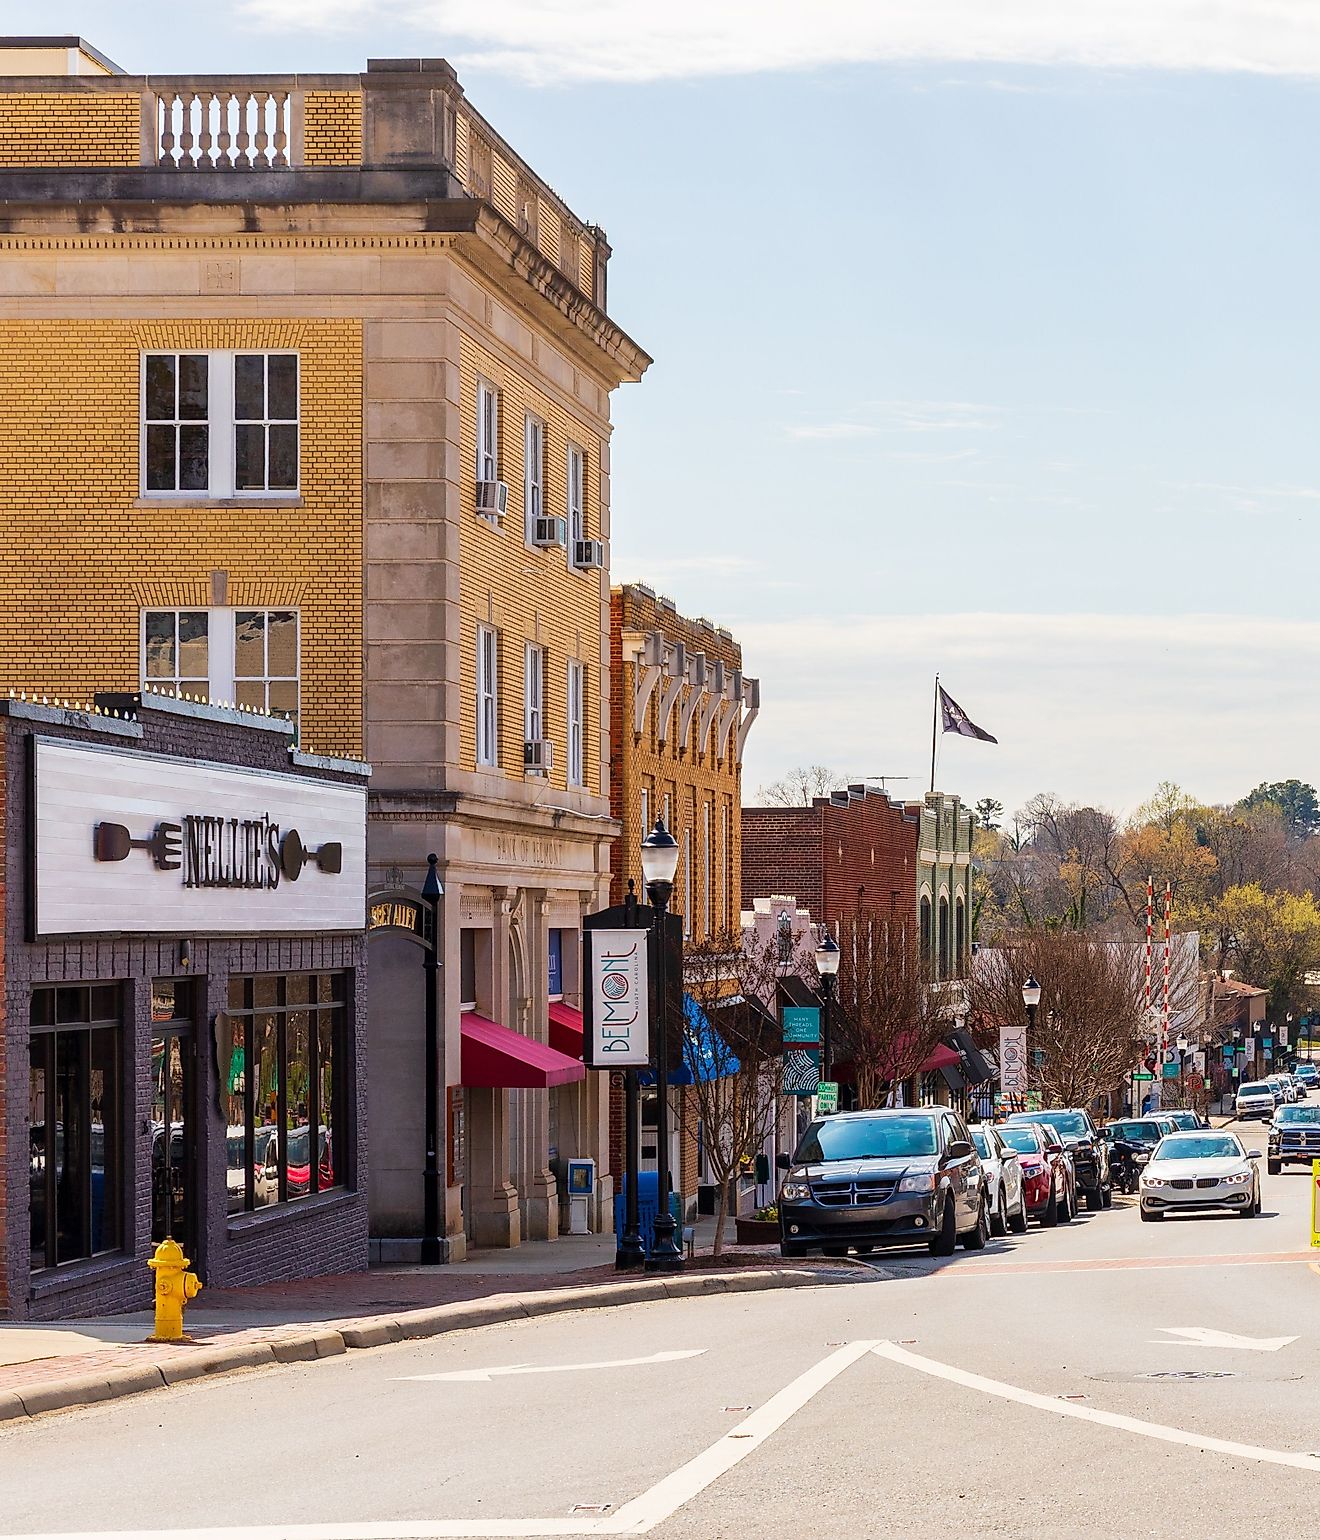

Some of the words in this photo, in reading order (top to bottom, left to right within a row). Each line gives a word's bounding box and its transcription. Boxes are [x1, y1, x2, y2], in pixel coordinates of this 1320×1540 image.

[183, 812, 280, 890] NELLIE'S
[496, 836, 517, 860] BANK
[521, 839, 529, 862] OF
[532, 840, 562, 865] BELMONT
[393, 903, 417, 930] ALLEY
[601, 943, 638, 1052] BELMONT
[820, 1102, 833, 1110] ONLY
